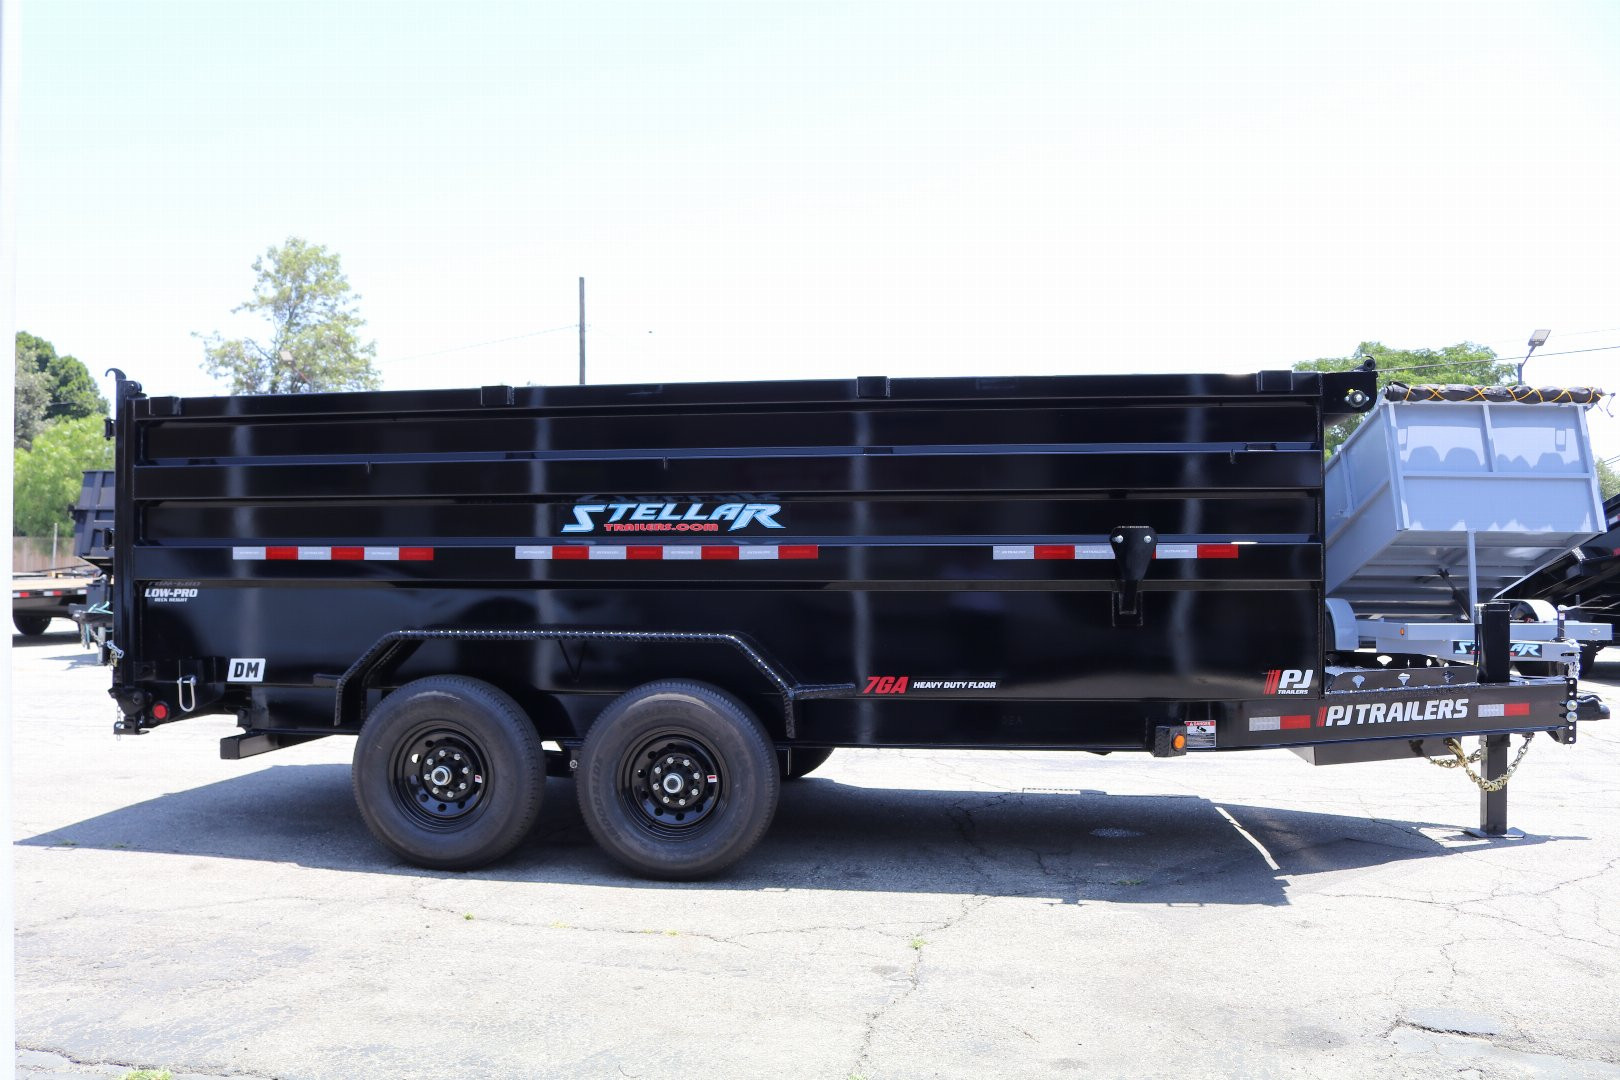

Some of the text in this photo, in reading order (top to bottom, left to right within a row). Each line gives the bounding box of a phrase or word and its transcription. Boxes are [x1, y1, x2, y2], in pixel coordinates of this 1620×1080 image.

[560, 502, 786, 533] STELLAR
[603, 523, 719, 532] TRAILERS.COM
[144, 588, 198, 597] LOW-PRO
[233, 662, 260, 678] DM
[1279, 669, 1314, 689] PJ
[863, 676, 909, 694] 7GA
[1325, 699, 1469, 727] PJ TRAILERS
